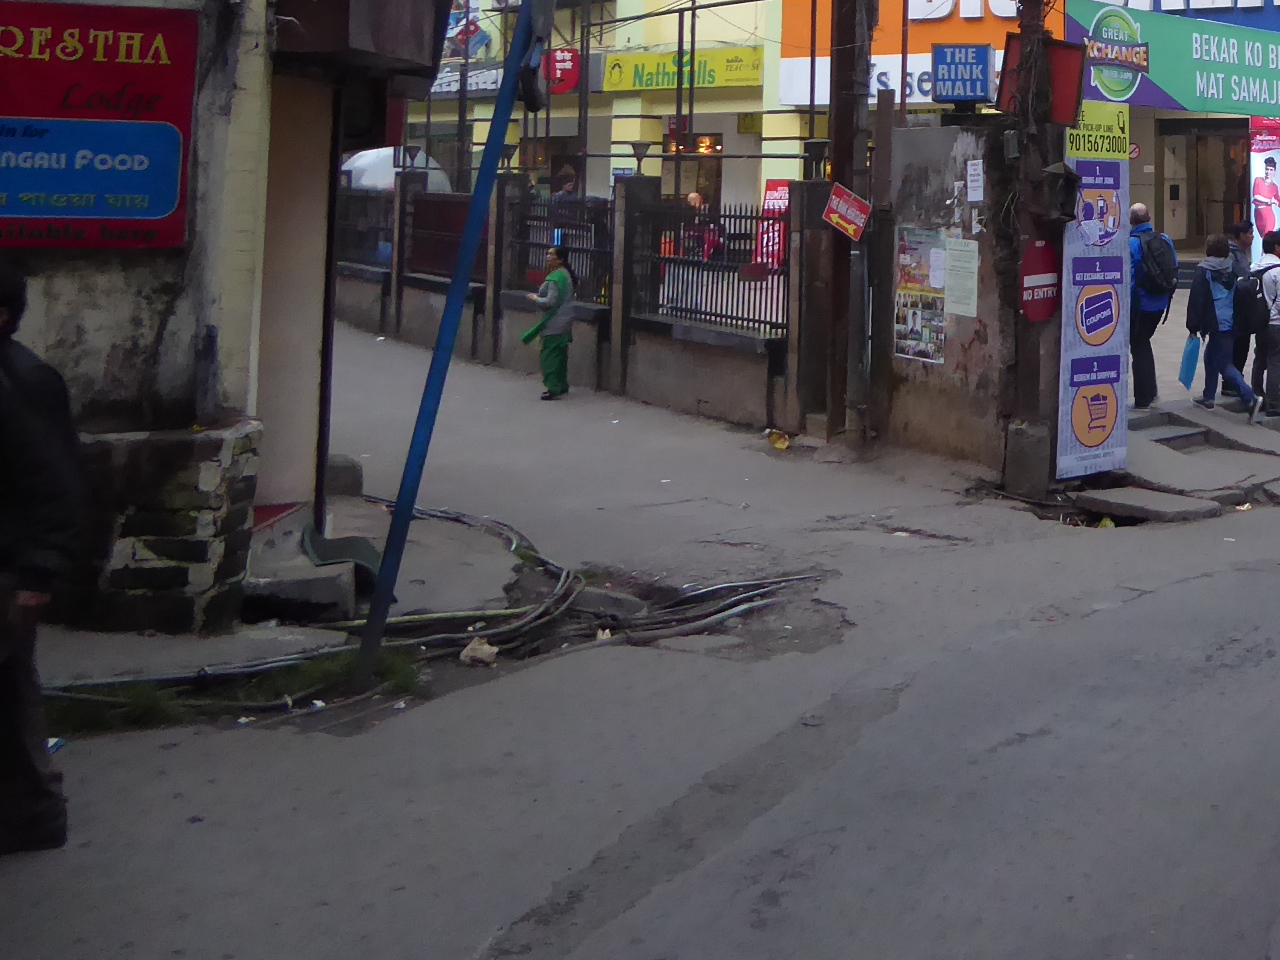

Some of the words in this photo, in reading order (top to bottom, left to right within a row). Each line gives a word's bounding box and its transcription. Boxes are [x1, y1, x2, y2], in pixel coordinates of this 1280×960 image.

[1102, 27, 1128, 41] GREAT
[944, 48, 976, 63] THE
[1192, 33, 1238, 64] BEKAR
[1245, 41, 1263, 67] KO
[938, 65, 983, 79] RINK
[936, 81, 985, 96] MALL
[1196, 71, 1224, 99] MAT
[60, 82, 163, 120] Lodge
[1069, 133, 1127, 154] 9015673000
[74, 149, 150, 171] FOOD
[1023, 289, 1032, 301] NO
[1033, 287, 1057, 300] ENTRY
